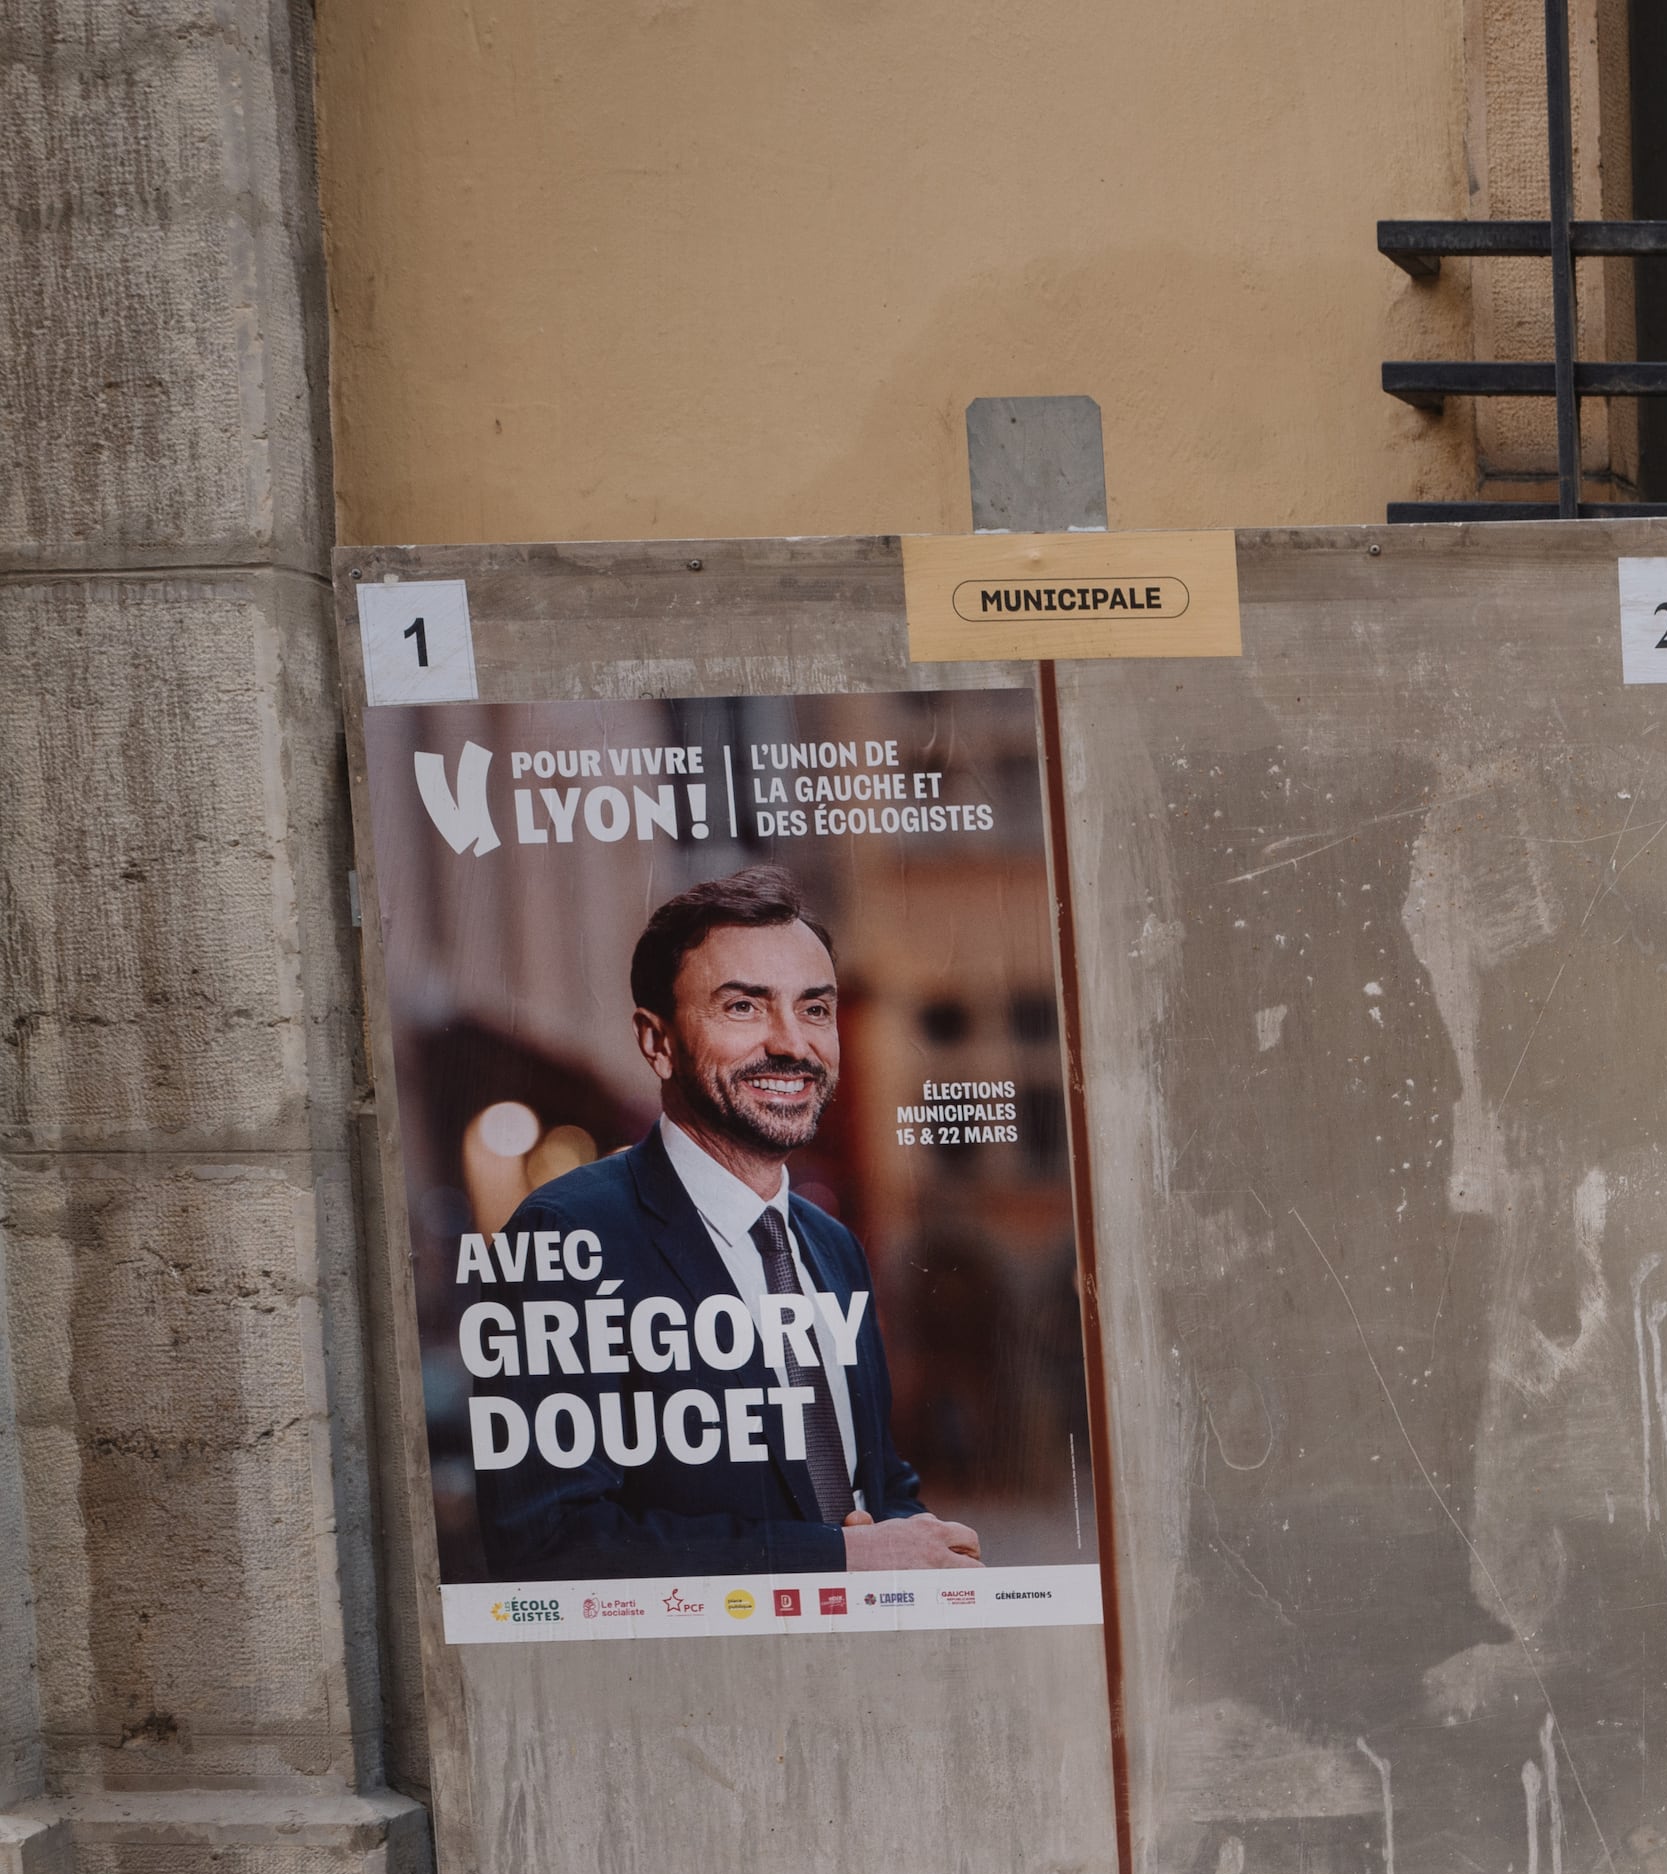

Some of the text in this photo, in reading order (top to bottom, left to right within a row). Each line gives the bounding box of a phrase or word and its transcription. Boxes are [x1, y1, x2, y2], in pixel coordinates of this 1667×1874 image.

[980, 587, 1162, 613] MUNICIPALE
[403, 617, 429, 668] 1
[511, 745, 705, 779] POUR VIVRE
[750, 740, 899, 770] L'UNION DE
[753, 772, 942, 804] LA GAUCHE ET
[756, 803, 994, 837] DES ÉCOLOGISTES
[922, 1079, 1016, 1101] ÉLECTIONS
[897, 1102, 1017, 1123] MUNICIPALES
[895, 1124, 1018, 1146] 15 & 22 MARS
[455, 1229, 603, 1284] AVEC
[458, 1279, 870, 1378] GRÉGORY
[468, 1386, 816, 1471] DOUCET
[511, 1596, 560, 1612] ÉCOLO
[601, 1600, 636, 1609] Le Parti
[941, 1590, 976, 1598] GAUCHE
[602, 1608, 645, 1617] socialiste
[684, 1603, 705, 1613] PCF
